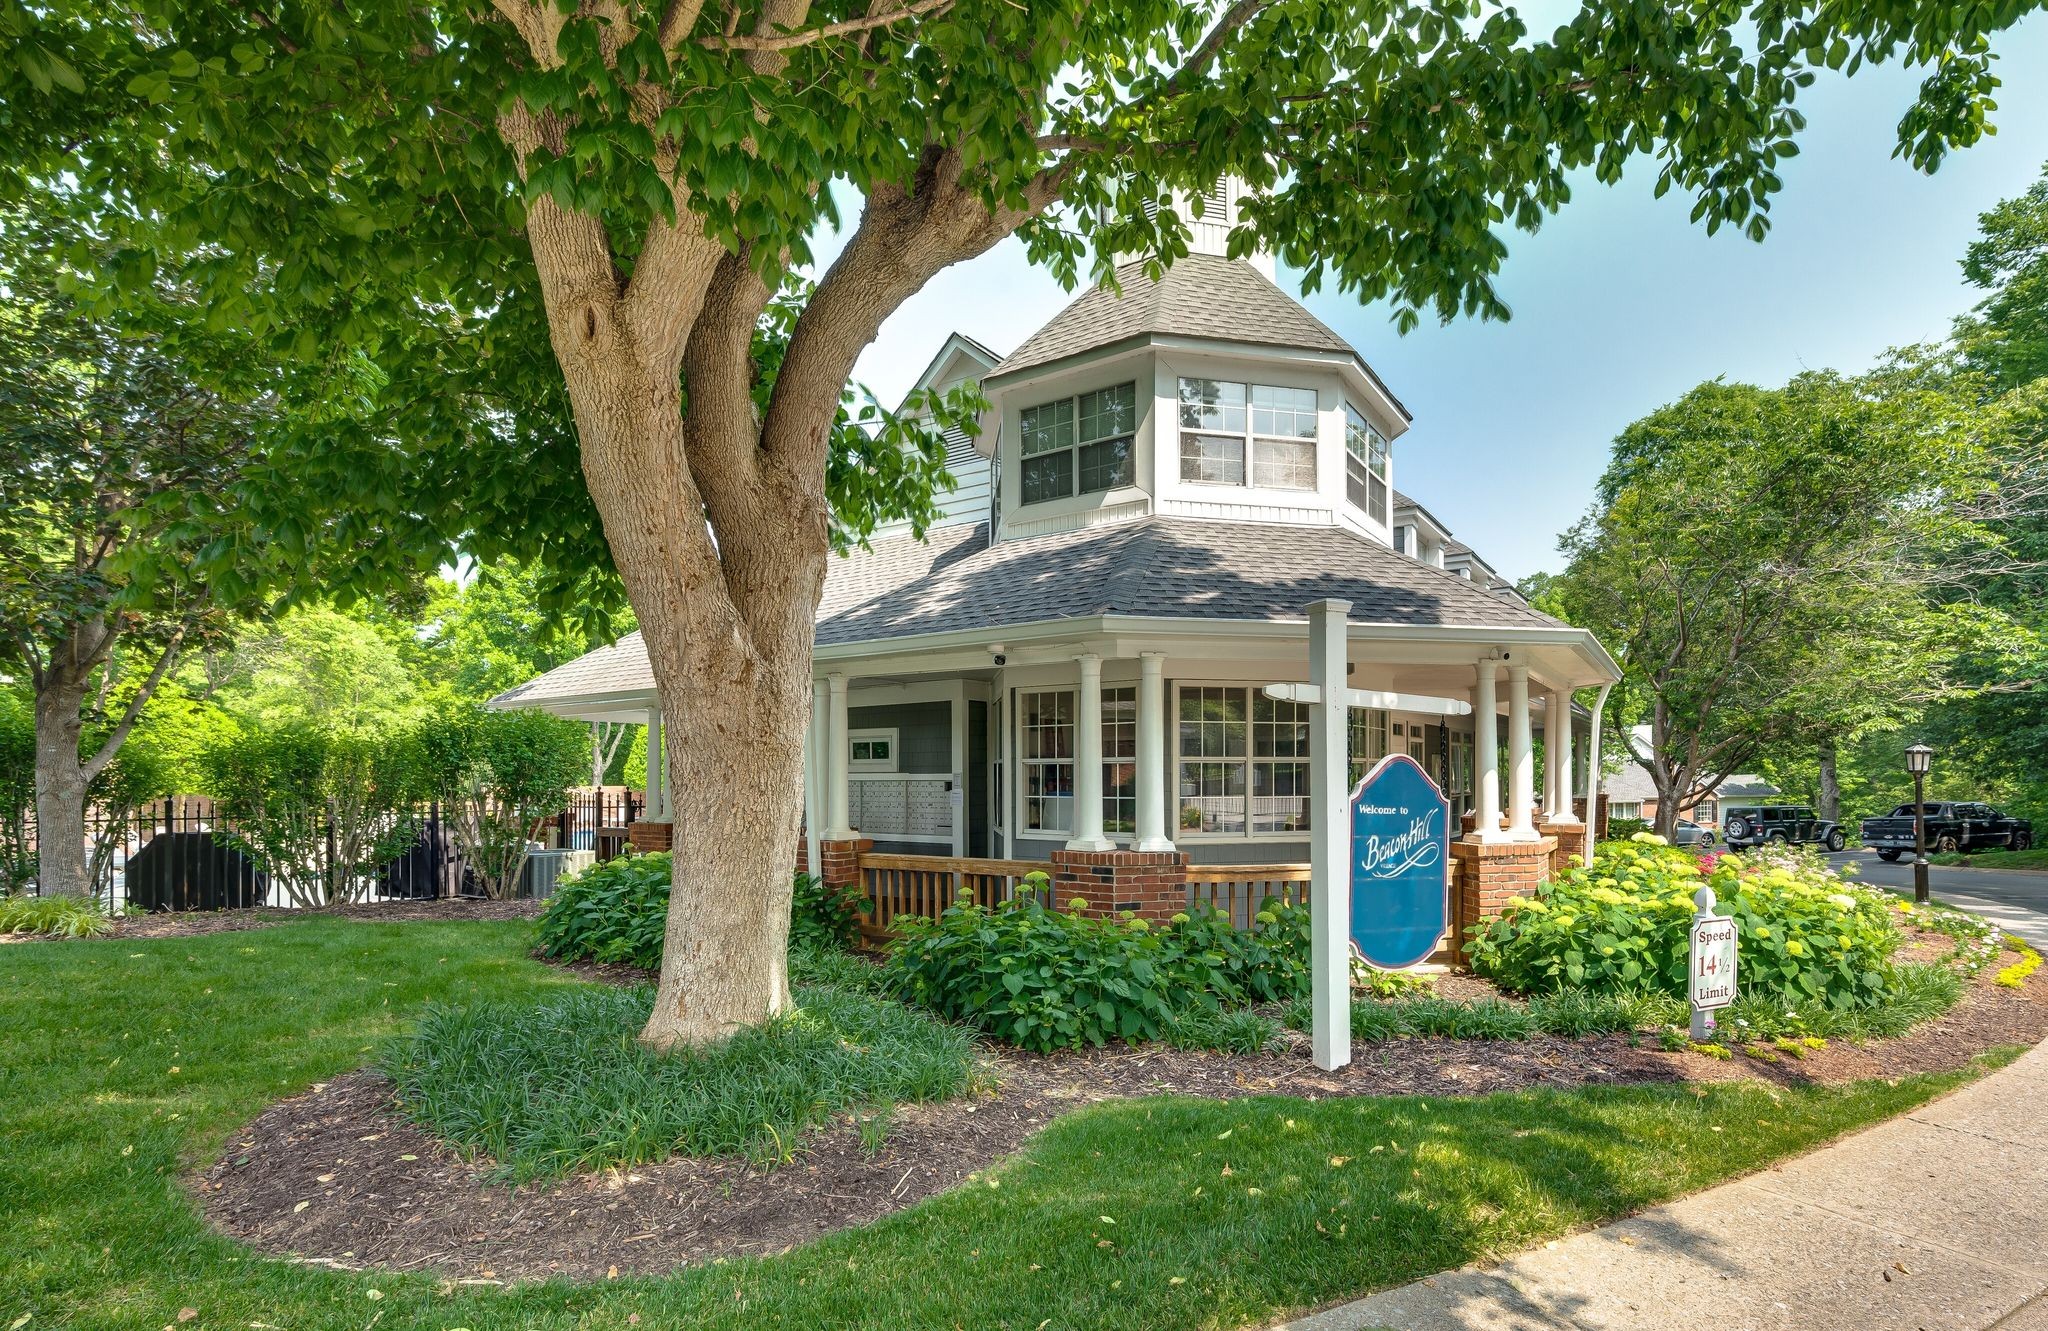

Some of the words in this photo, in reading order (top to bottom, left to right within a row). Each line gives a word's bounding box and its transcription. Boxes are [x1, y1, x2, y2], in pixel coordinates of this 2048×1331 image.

[1359, 804, 1396, 814] Welcome
[1400, 806, 1408, 814] to
[1362, 834, 1407, 871] Beacon
[1405, 808, 1439, 849] Hill
[1699, 929, 1731, 945] Speed
[1699, 985, 1728, 1000] Limit
